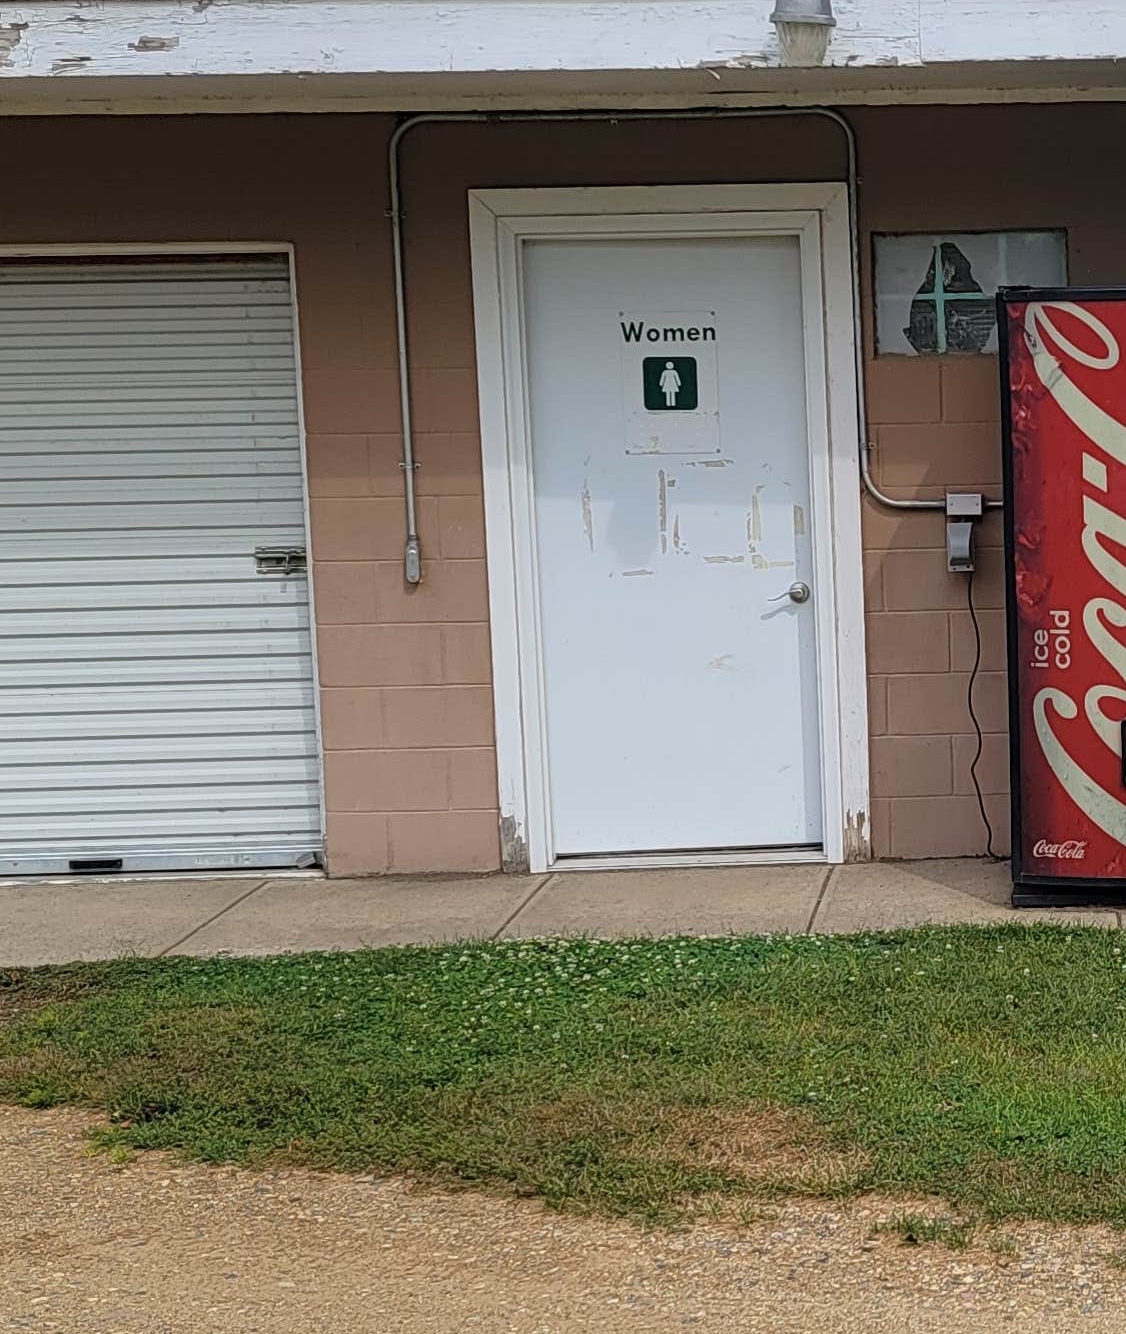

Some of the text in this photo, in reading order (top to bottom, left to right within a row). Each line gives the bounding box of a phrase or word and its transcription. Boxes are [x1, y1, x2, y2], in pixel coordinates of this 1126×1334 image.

[620, 321, 717, 343] Women
[1030, 629, 1049, 668] ice
[1049, 610, 1071, 670] cold
